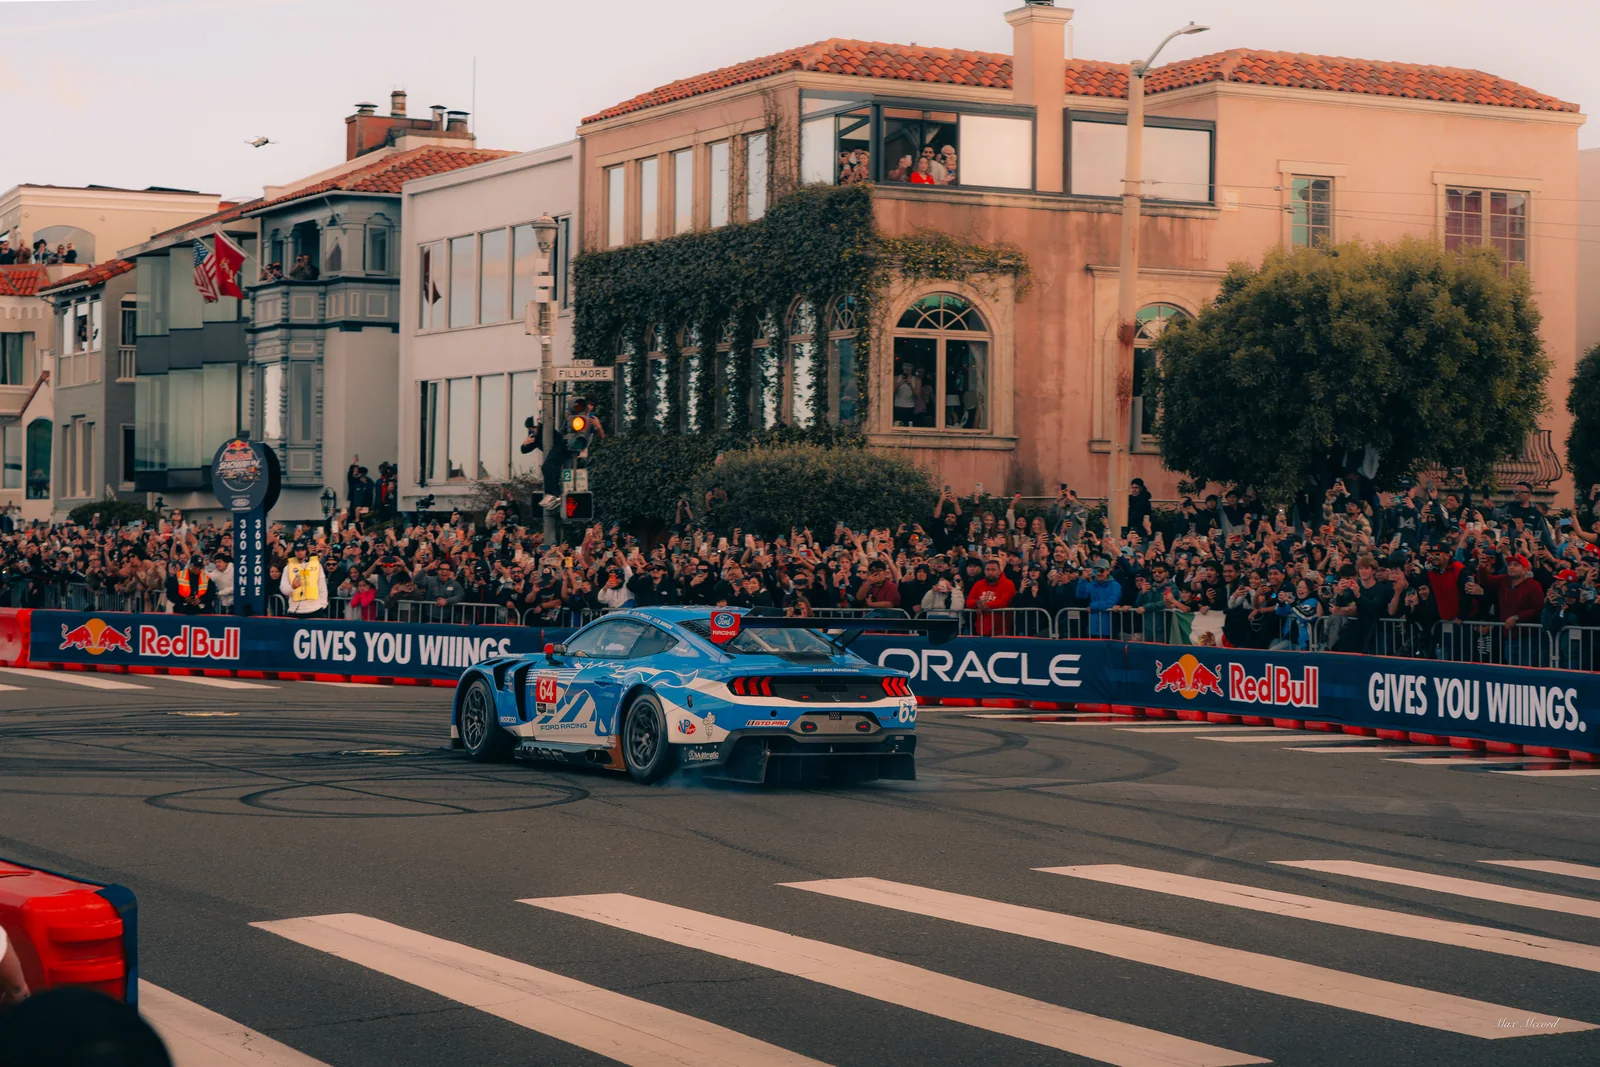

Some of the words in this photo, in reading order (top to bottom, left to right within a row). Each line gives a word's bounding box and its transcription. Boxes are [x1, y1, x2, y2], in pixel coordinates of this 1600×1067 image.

[558, 369, 608, 378] FILLMORE
[564, 472, 571, 480] 2
[239, 519, 247, 550] 360
[254, 519, 262, 550] 360
[239, 555, 247, 596] ZONE
[253, 554, 262, 596] ZONE
[718, 614, 731, 625] Ford
[139, 625, 190, 657] Red
[191, 627, 240, 660] Bull
[293, 629, 356, 662] GIVES
[363, 632, 412, 664] YOU
[878, 648, 1082, 687] ORACLE
[540, 679, 554, 700] 64
[1229, 662, 1273, 704] Red
[1274, 665, 1319, 708] Bull
[899, 700, 917, 723] 65
[1369, 672, 1427, 715] GIVES
[1433, 677, 1480, 720] YOU
[1486, 681, 1587, 732] WIIINGS.
[679, 719, 691, 734] VP
